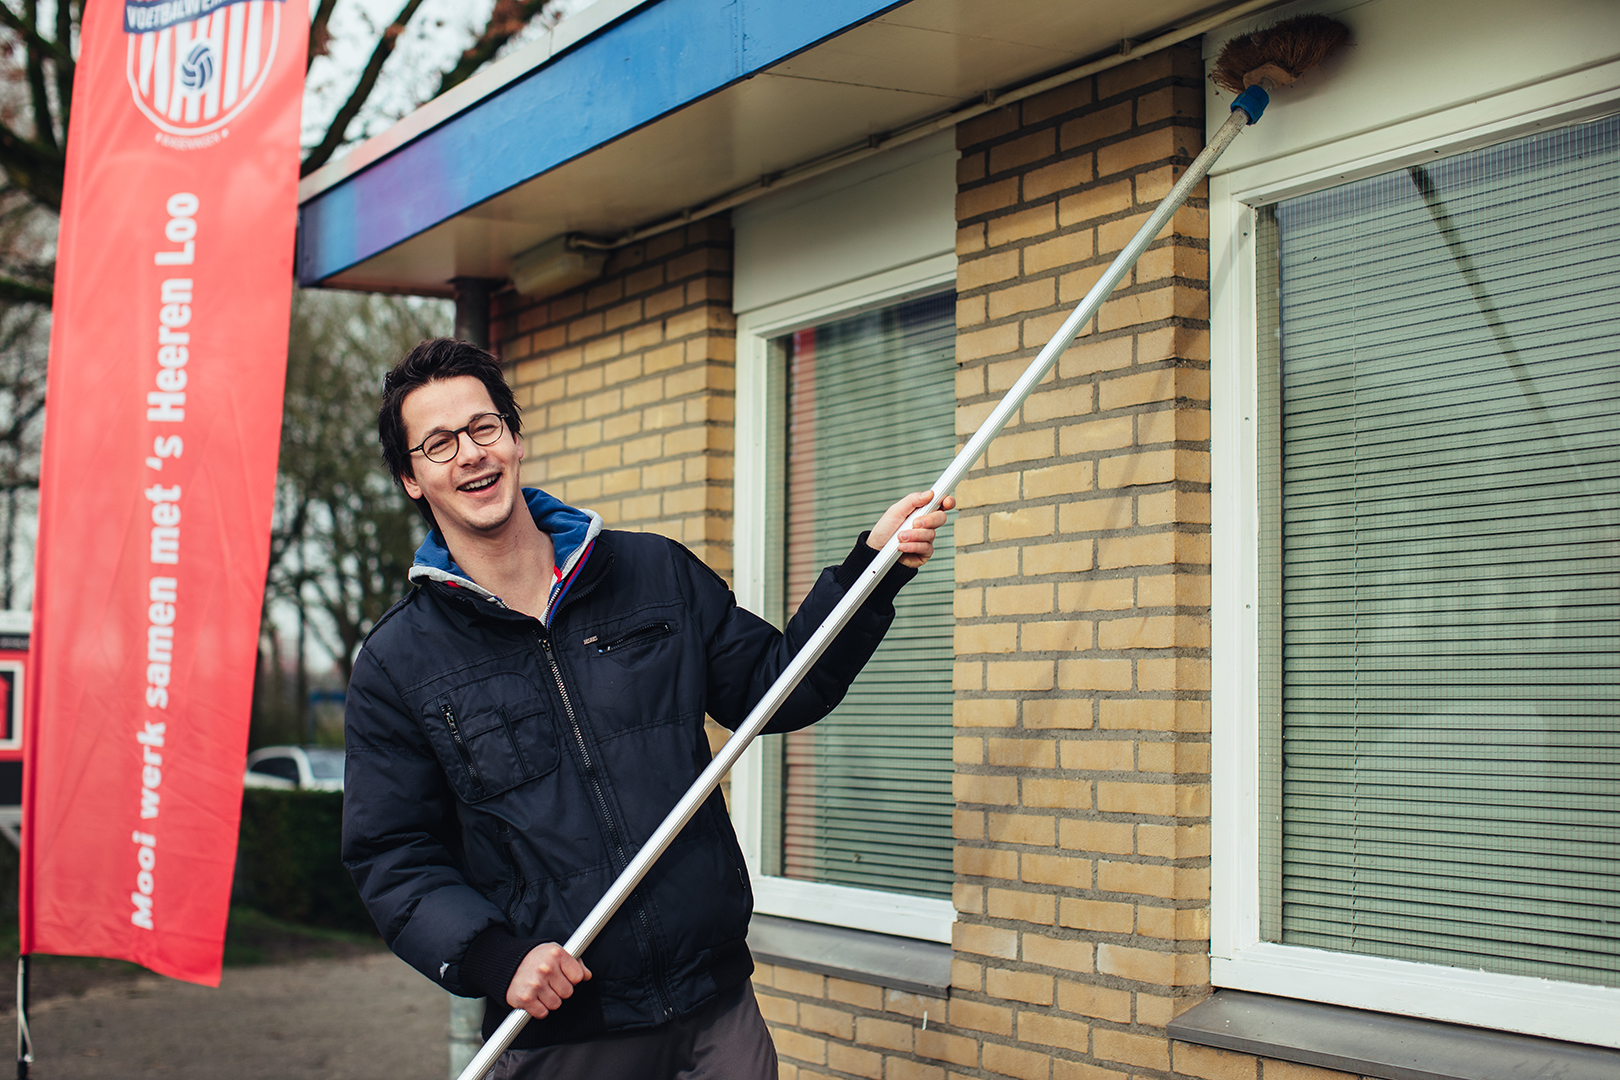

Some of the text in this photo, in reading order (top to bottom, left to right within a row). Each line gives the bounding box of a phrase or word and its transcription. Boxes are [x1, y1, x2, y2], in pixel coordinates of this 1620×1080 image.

[153, 191, 200, 266] Loo
[146, 277, 194, 423] Heeren
[143, 483, 182, 565] met
[145, 576, 178, 709] samen
[136, 721, 166, 819] werk
[131, 831, 156, 930] Mooi
